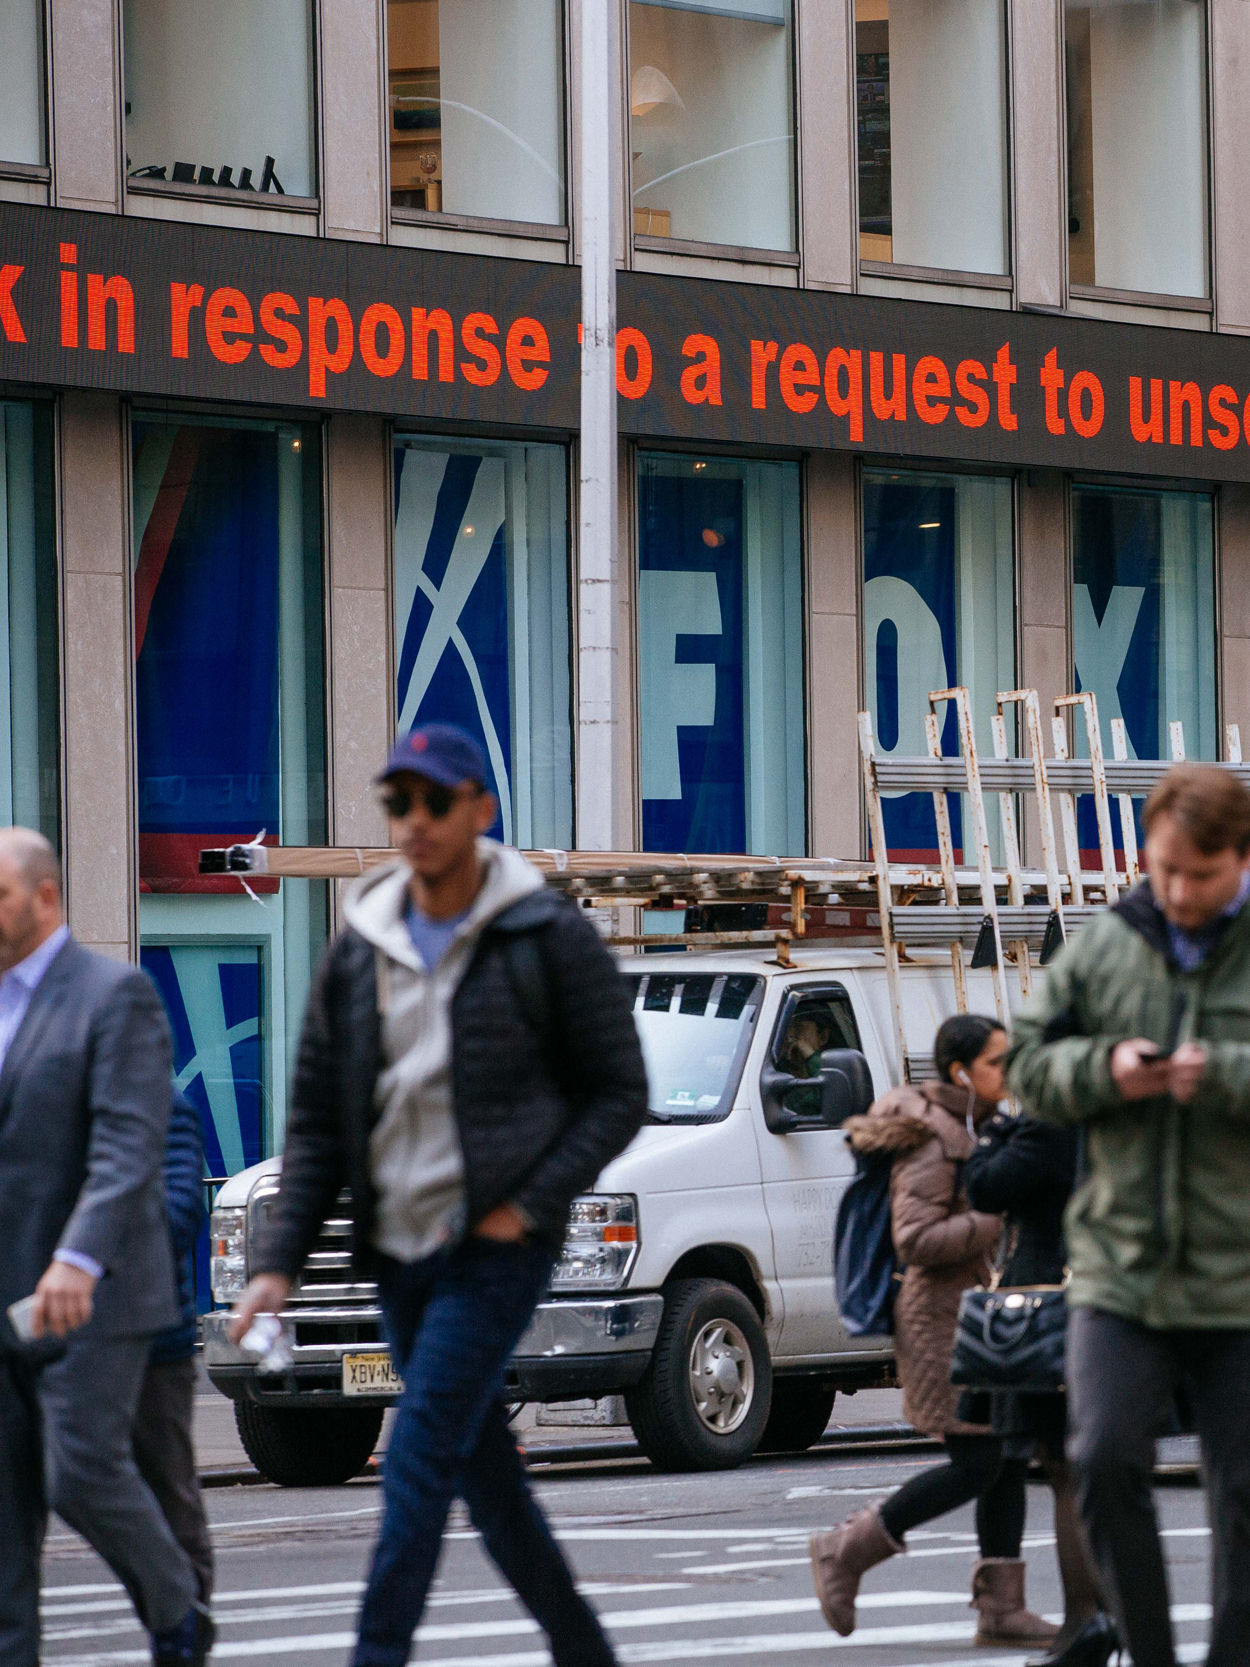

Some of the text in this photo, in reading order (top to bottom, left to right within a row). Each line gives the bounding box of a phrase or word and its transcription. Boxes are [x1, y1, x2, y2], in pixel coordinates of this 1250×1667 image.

[60, 242, 135, 354] in
[170, 282, 551, 398] response
[577, 323, 653, 400] o
[680, 333, 723, 406] a
[750, 338, 1019, 442] request
[1039, 346, 1105, 439] to
